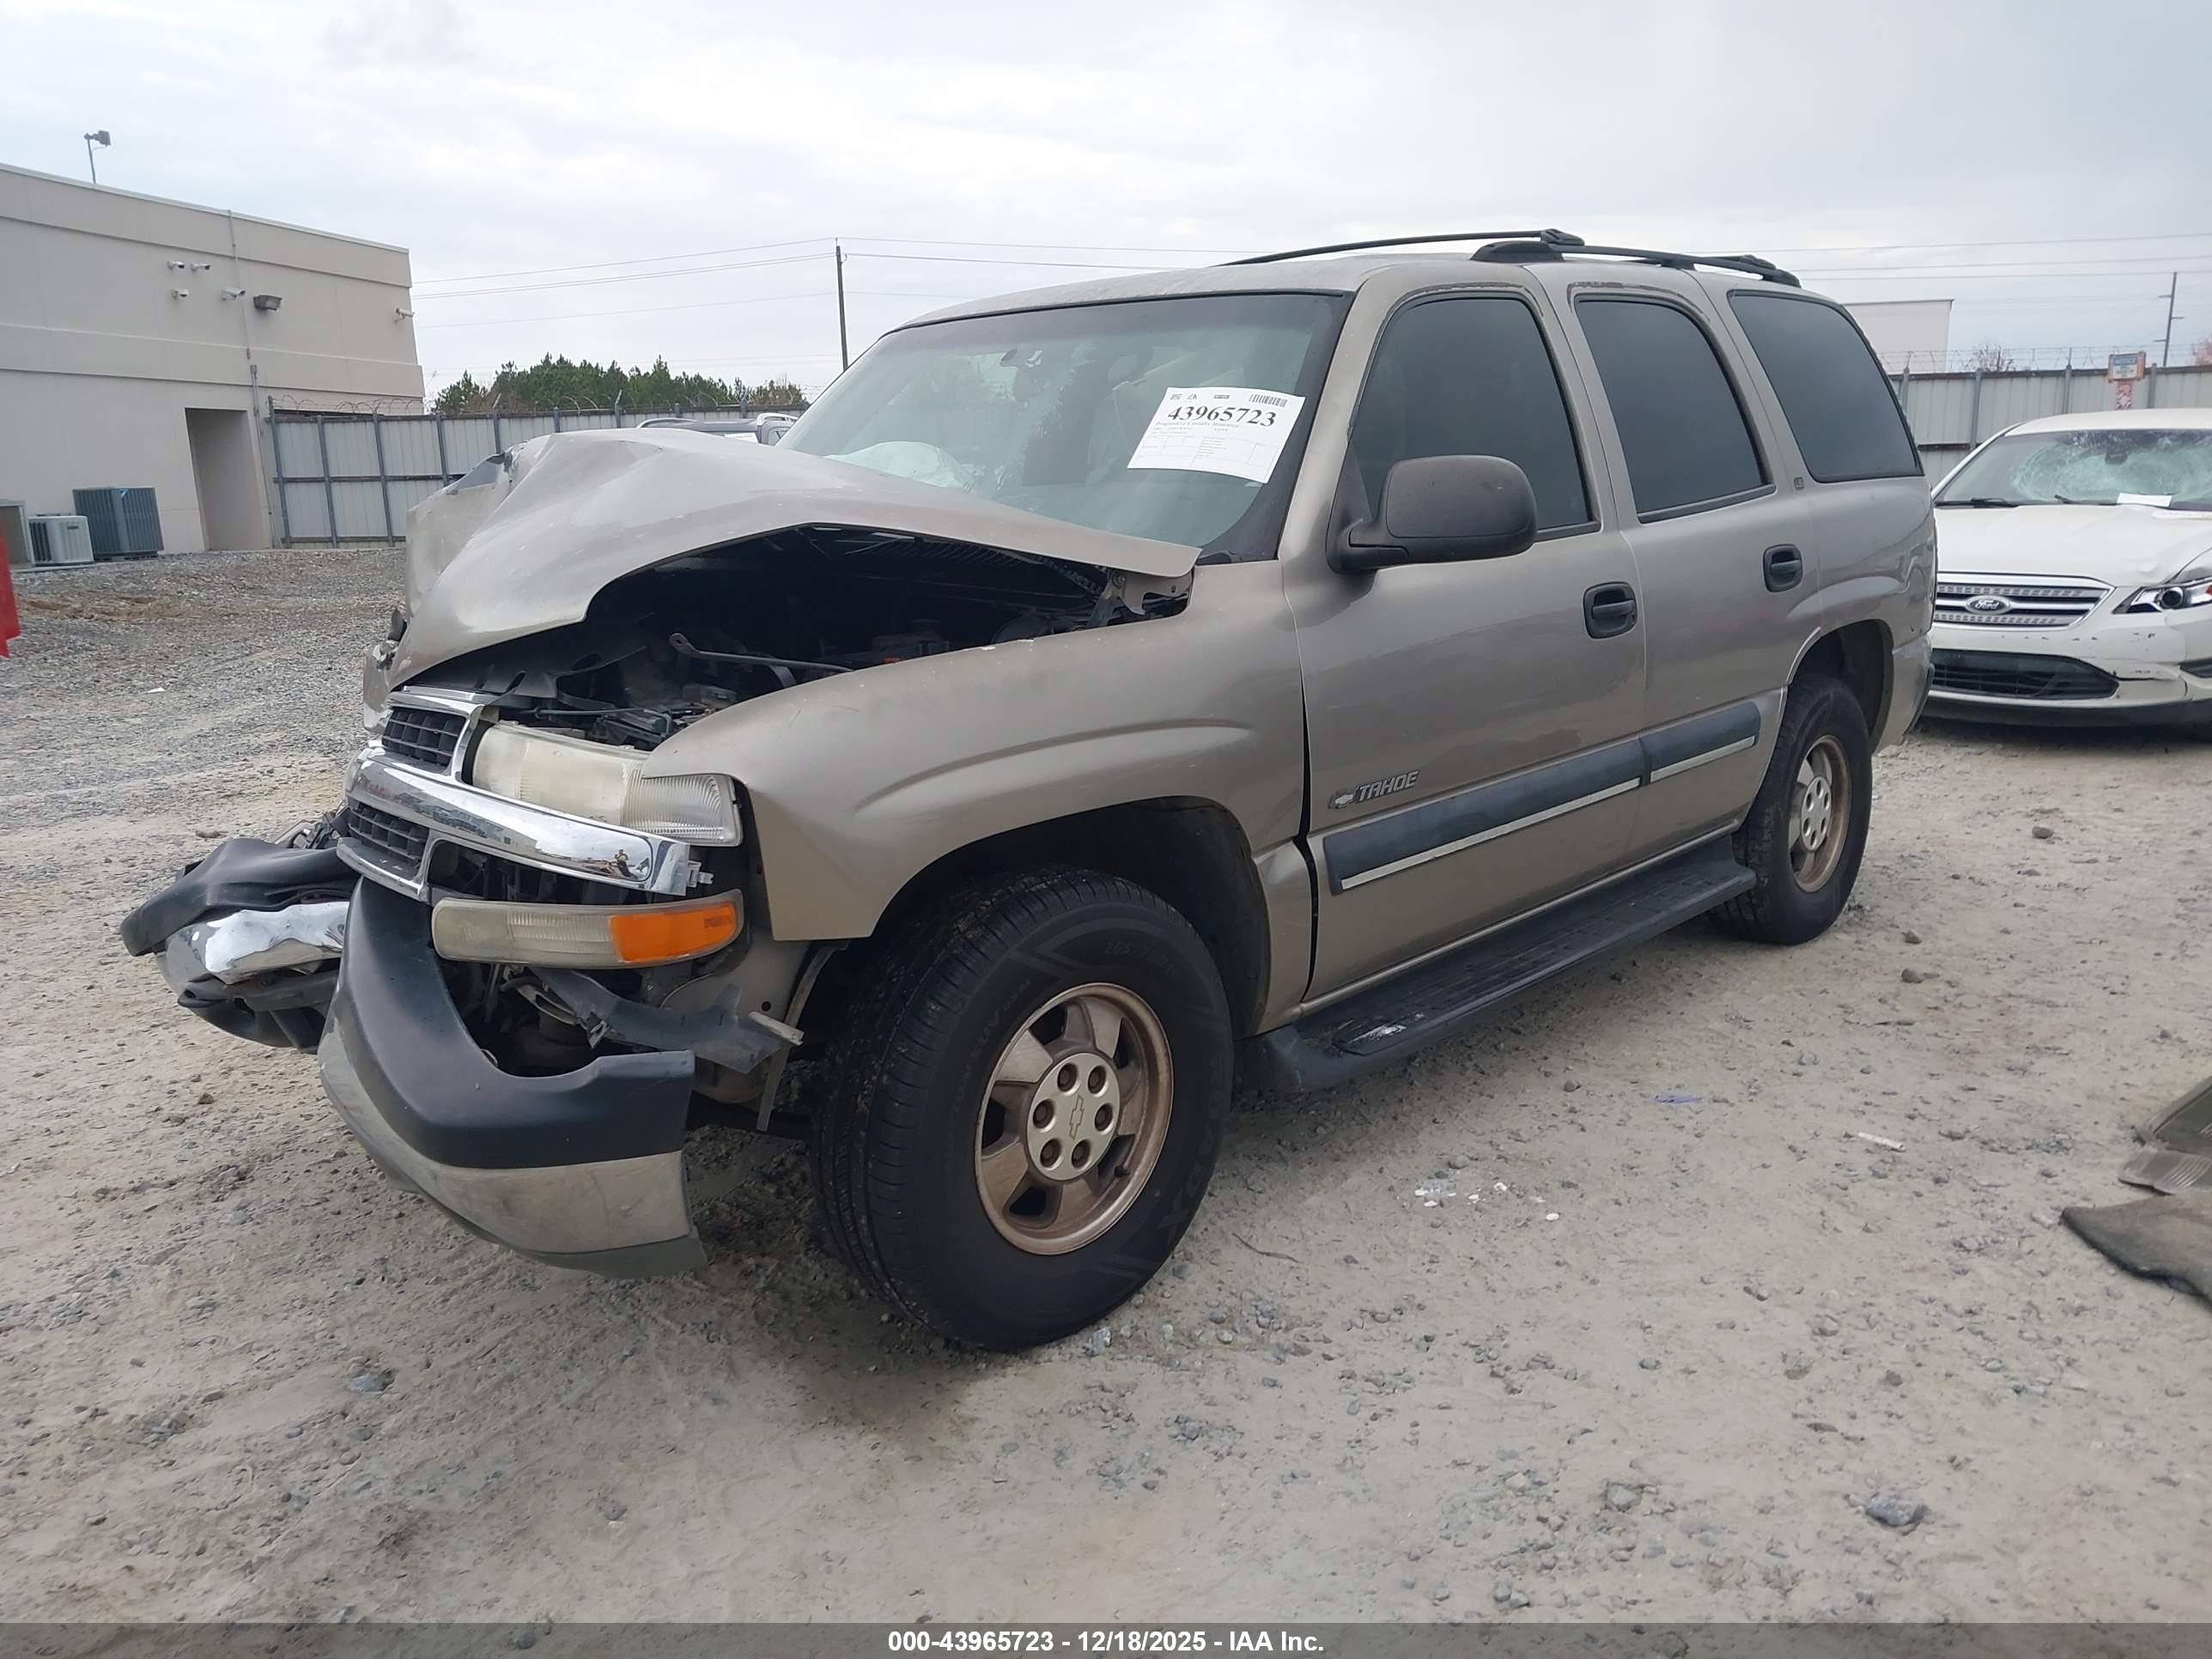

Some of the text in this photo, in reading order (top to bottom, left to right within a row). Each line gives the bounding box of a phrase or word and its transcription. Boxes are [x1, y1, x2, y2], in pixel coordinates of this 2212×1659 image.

[1168, 405, 1277, 427] 43965723
[1975, 598, 2000, 610] Ford
[1358, 770, 1419, 801] TAHOE
